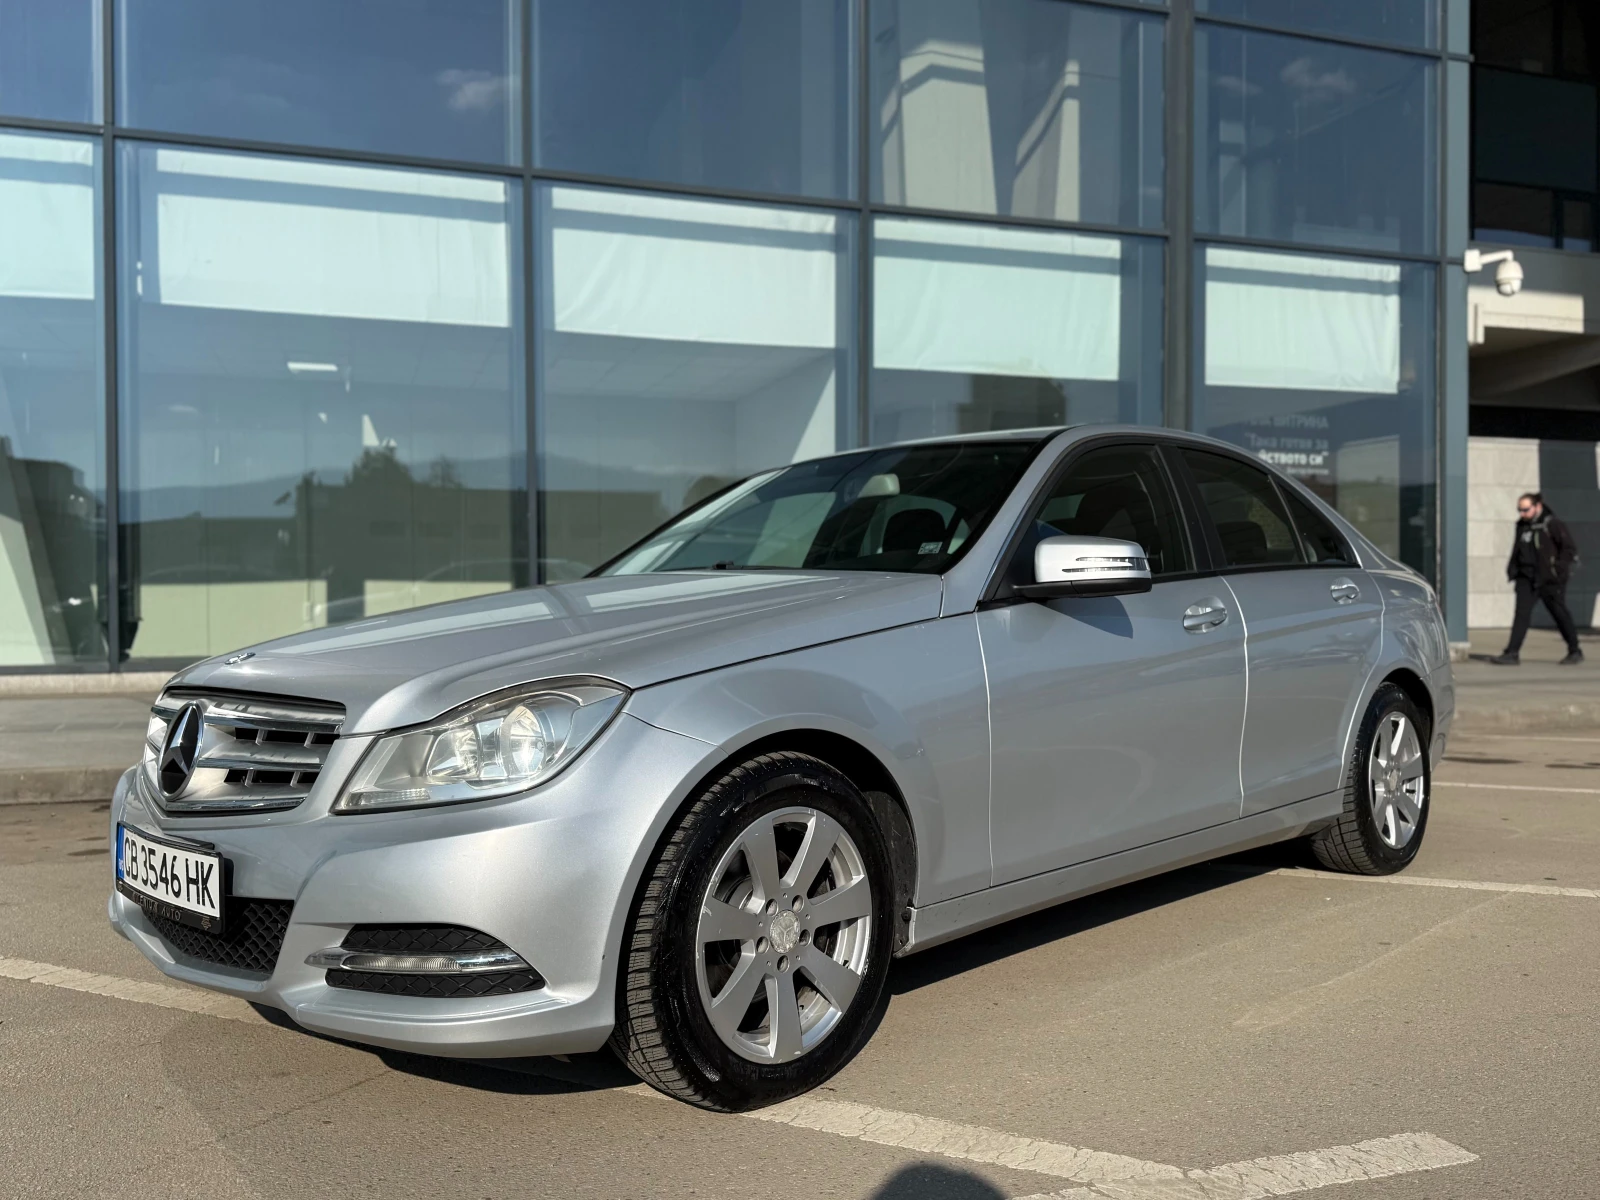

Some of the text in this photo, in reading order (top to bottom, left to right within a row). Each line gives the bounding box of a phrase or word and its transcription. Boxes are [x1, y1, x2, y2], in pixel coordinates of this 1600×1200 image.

[125, 837, 216, 909] CB 3546 HK
